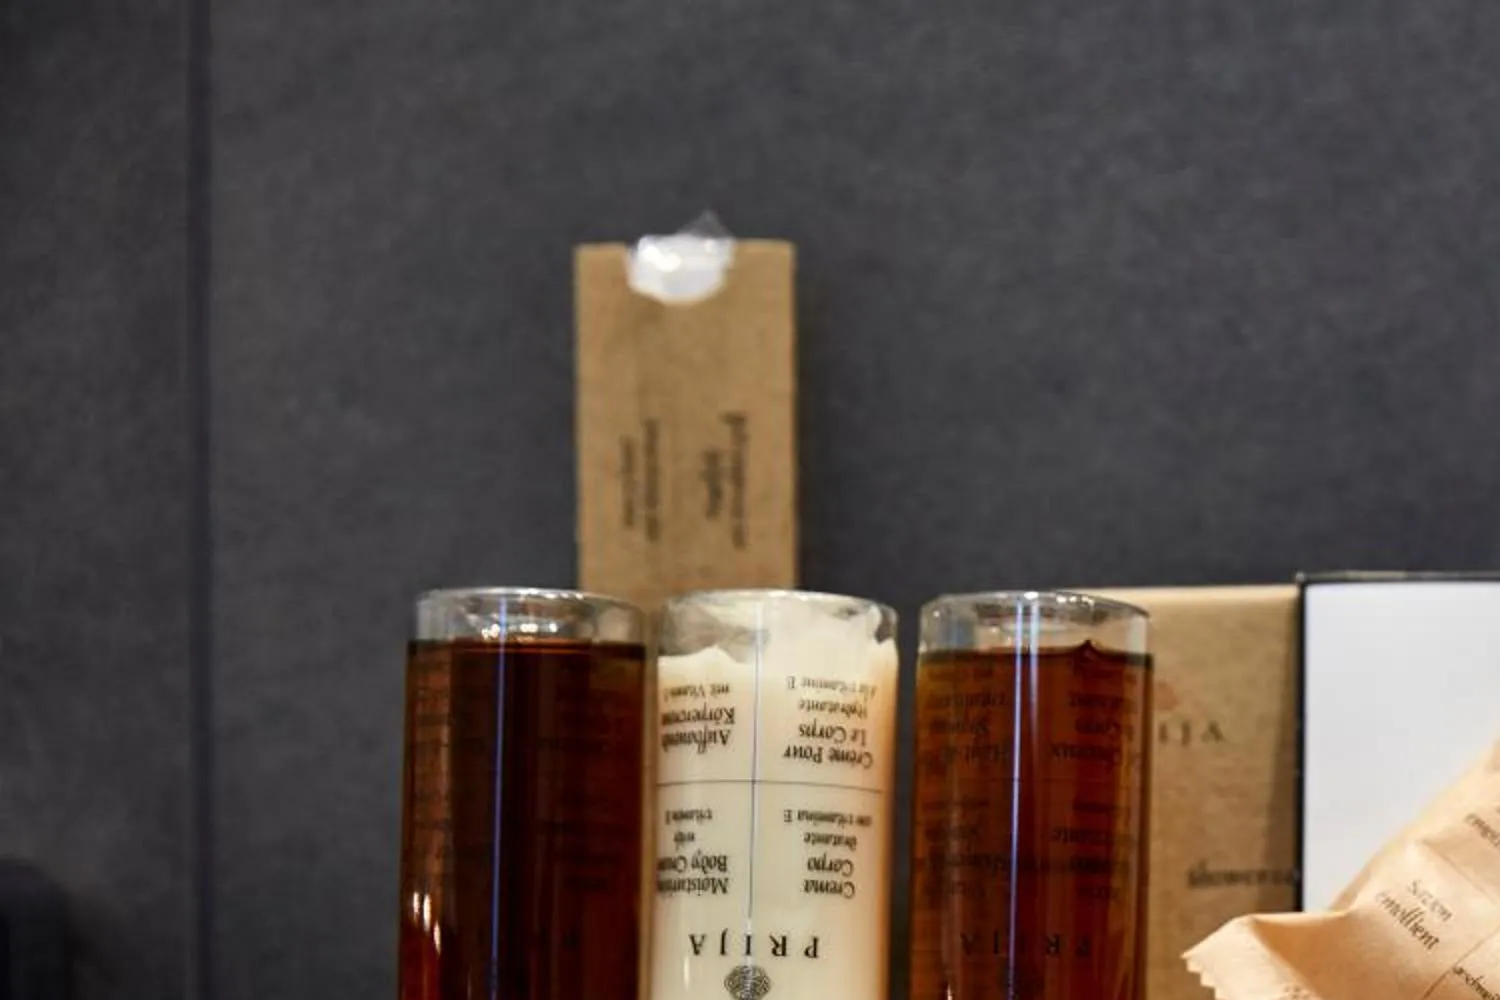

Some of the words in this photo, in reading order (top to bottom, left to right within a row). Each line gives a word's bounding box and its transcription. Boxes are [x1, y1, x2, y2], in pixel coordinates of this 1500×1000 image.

[799, 717, 847, 744] Corps
[783, 744, 824, 765] Pour
[689, 850, 729, 875] Body
[807, 851, 855, 878] Corpo
[802, 878, 857, 900] Crema
[1375, 889, 1441, 951] emollient
[688, 927, 820, 959] PRIJA
